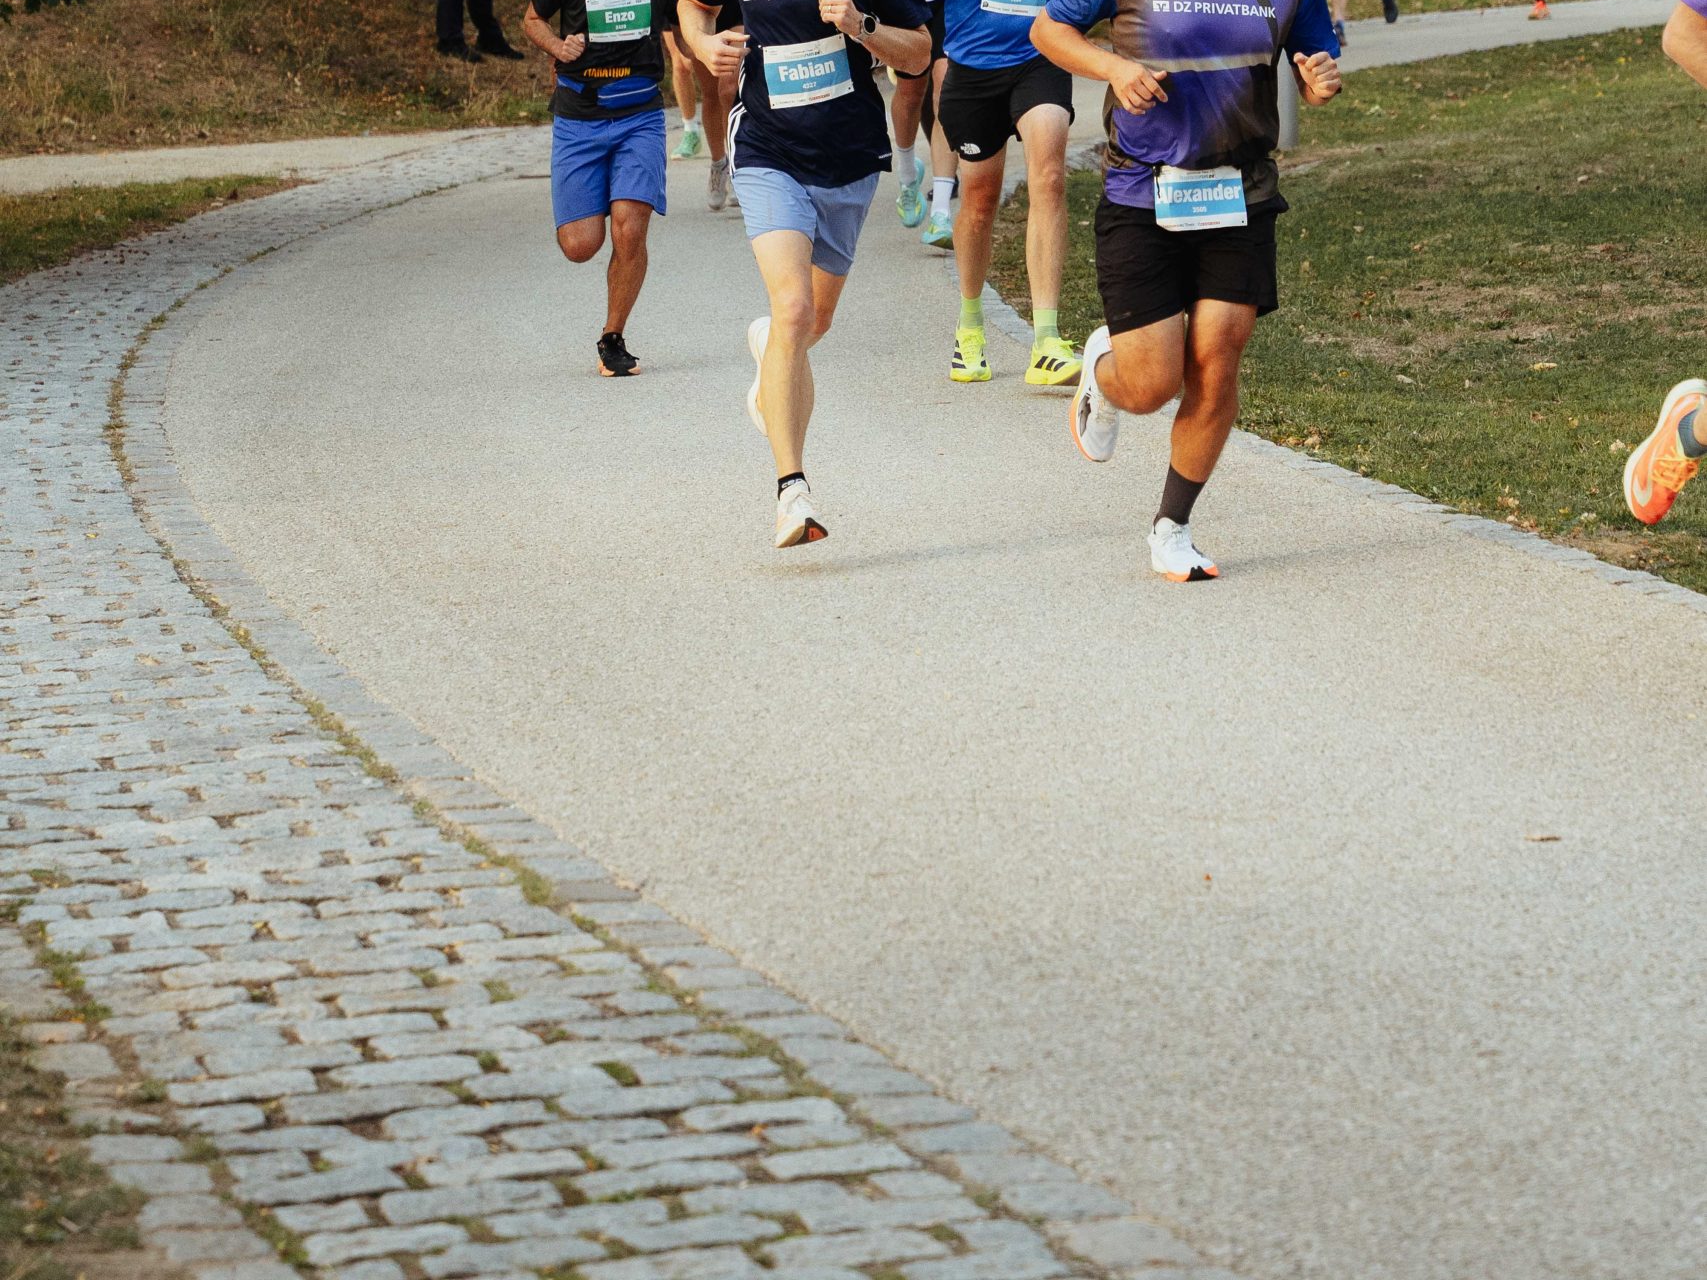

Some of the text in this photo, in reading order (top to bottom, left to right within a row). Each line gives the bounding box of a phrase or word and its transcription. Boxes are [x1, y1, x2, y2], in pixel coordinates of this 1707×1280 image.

[605, 11, 636, 24] Enzo
[1173, 1, 1276, 19] DZ PRIVATBANK
[778, 60, 836, 82] Fabian
